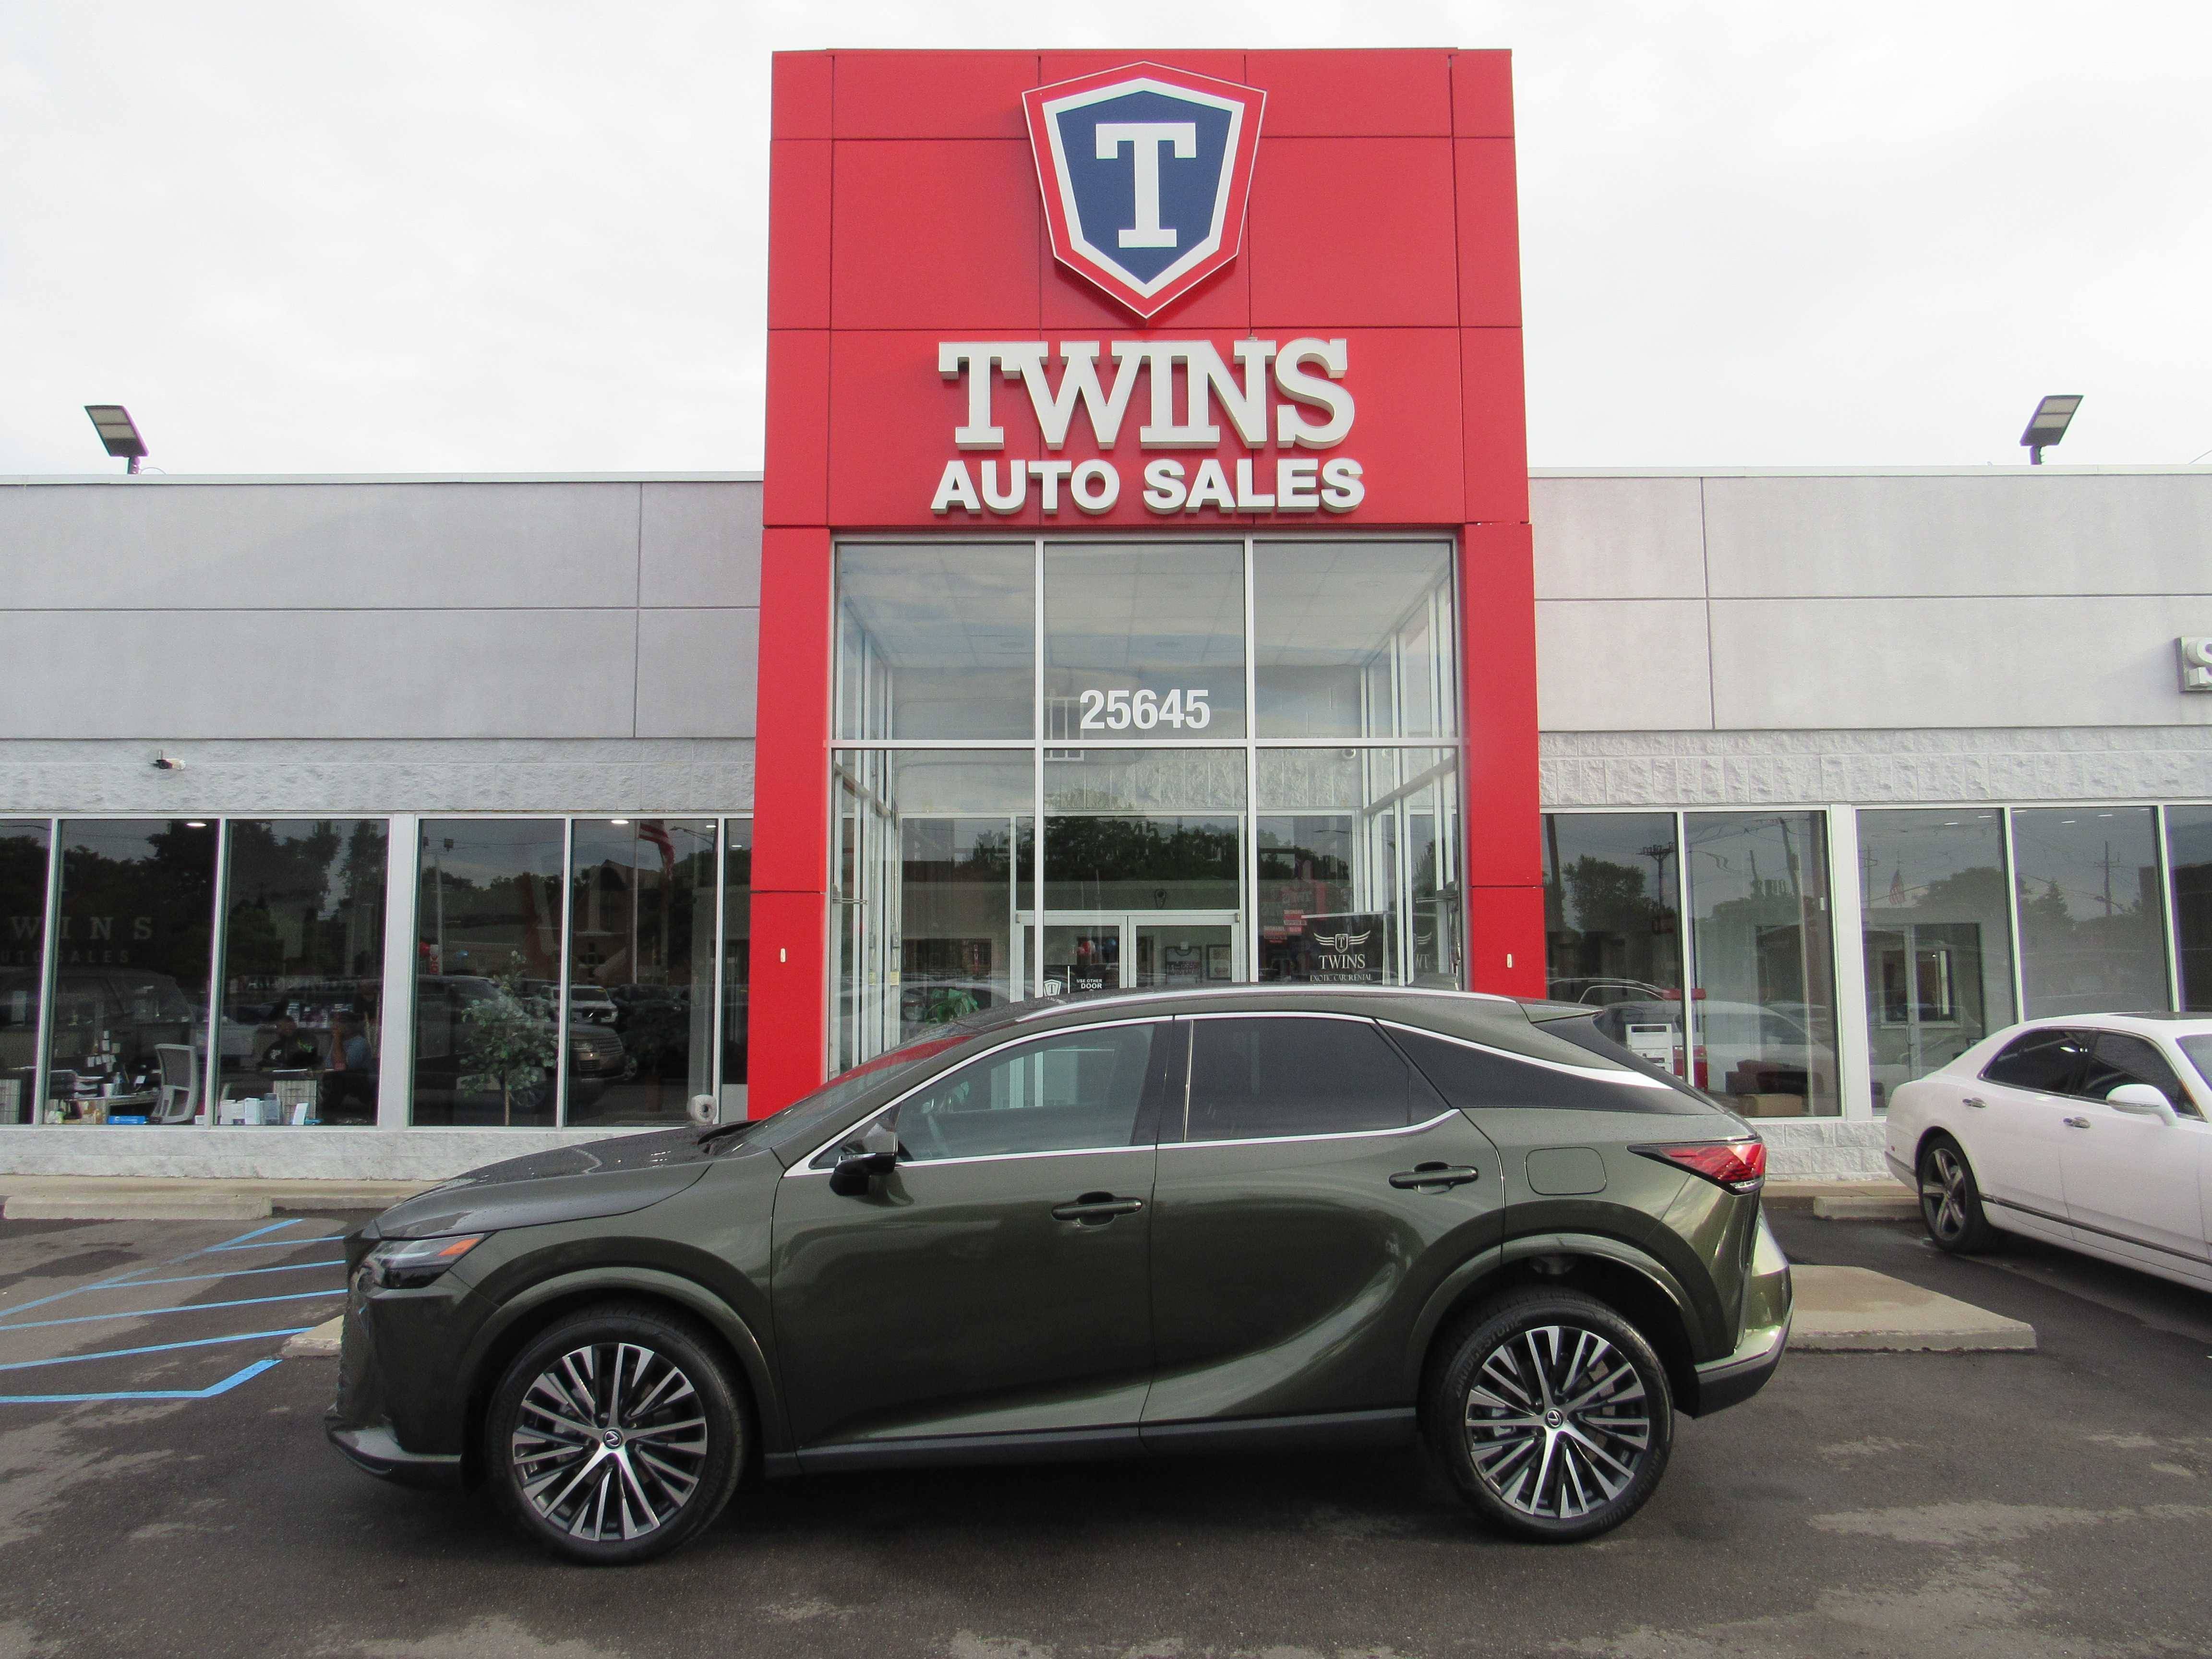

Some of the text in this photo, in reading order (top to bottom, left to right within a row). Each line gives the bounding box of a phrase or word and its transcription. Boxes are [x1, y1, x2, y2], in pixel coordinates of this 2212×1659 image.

[1095, 122, 1197, 248] T
[938, 337, 1355, 450] TWINS
[930, 457, 1365, 516] AUTO SALES
[1080, 689, 1210, 730] 25645
[1318, 953, 1366, 970] TWINS
